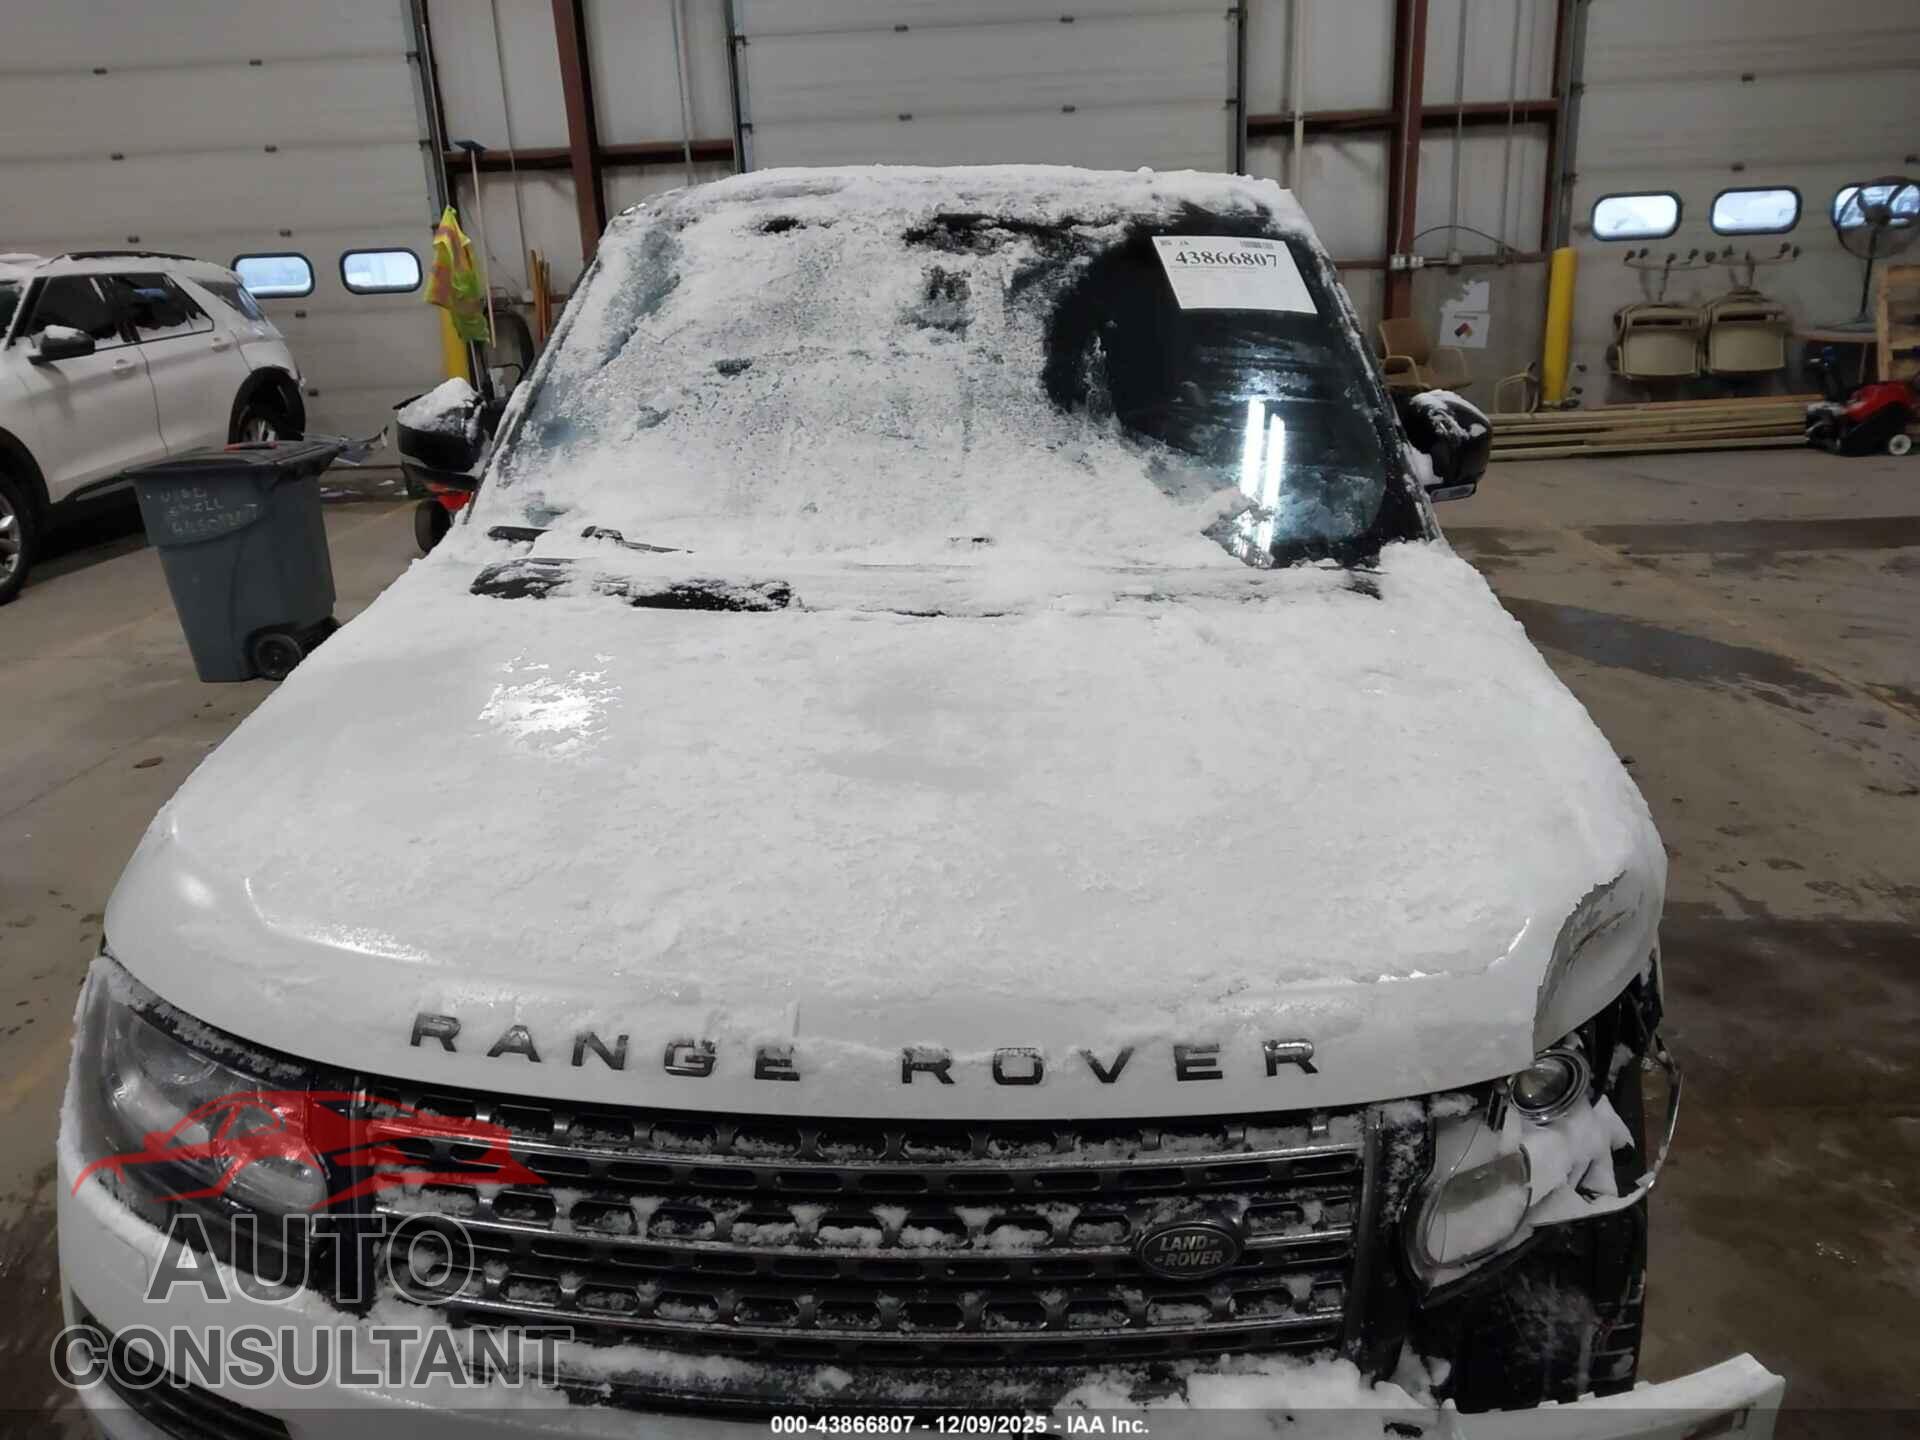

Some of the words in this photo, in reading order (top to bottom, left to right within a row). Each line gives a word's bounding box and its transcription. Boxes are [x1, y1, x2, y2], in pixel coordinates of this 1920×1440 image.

[1175, 250, 1279, 268] 43866807
[410, 1011, 800, 1082] RANGE
[901, 1037, 1319, 1086] ROVER
[1160, 1235, 1208, 1251] LAND
[1164, 1250, 1223, 1266] ROVER
